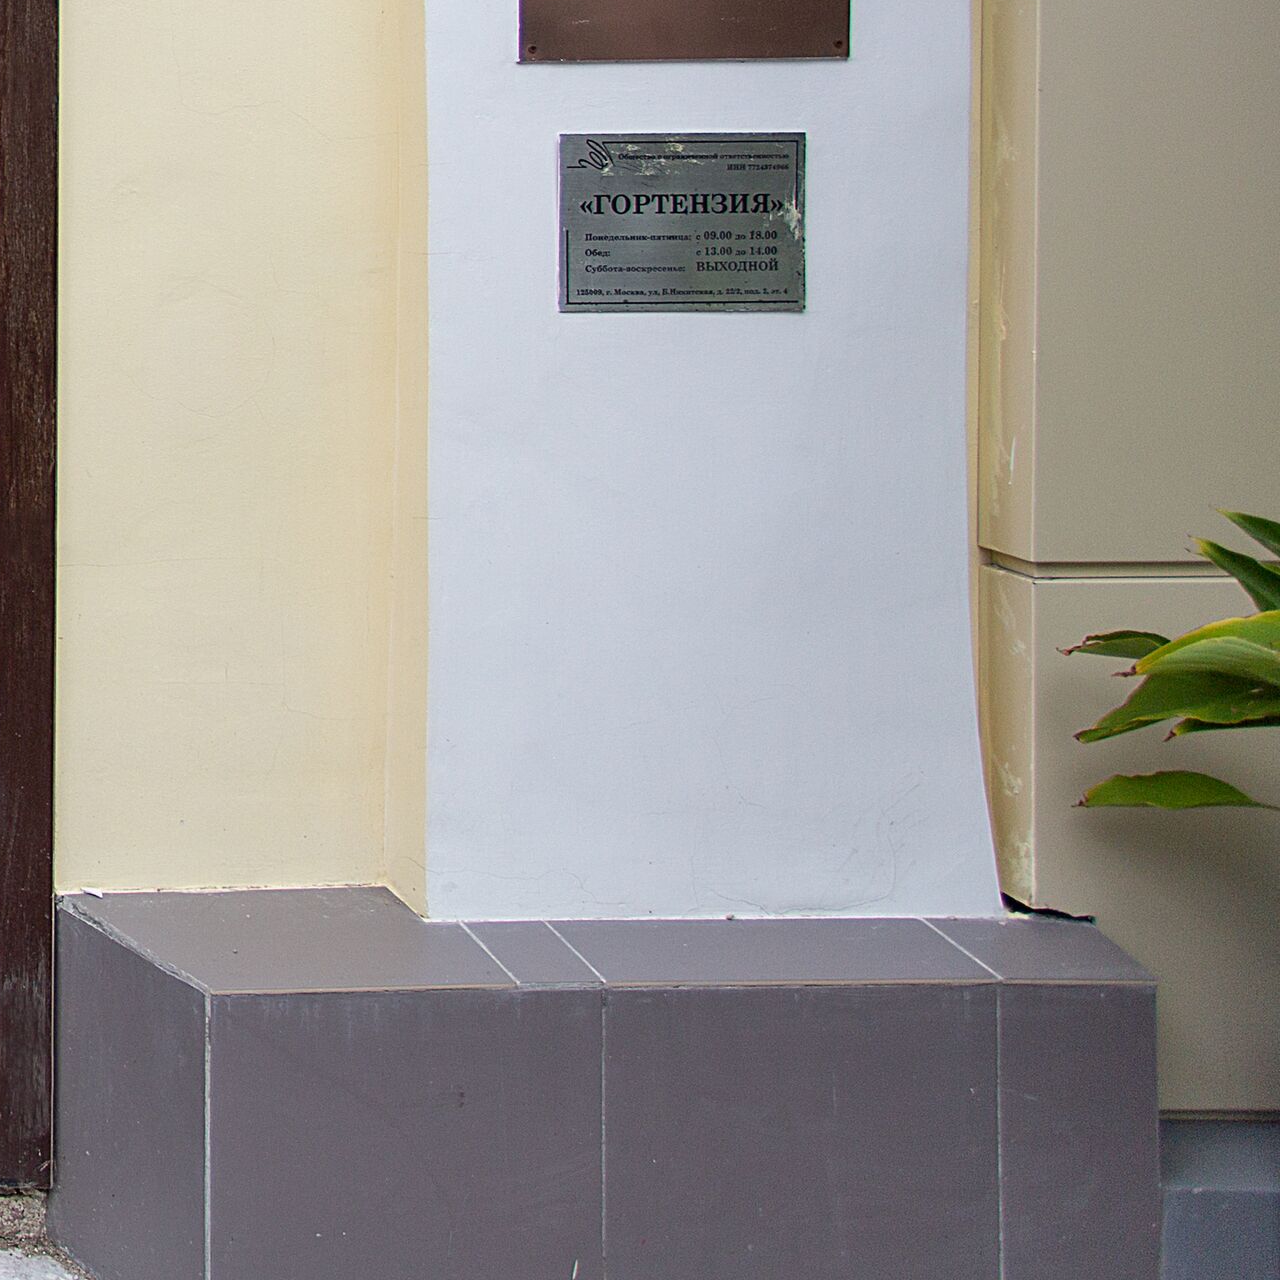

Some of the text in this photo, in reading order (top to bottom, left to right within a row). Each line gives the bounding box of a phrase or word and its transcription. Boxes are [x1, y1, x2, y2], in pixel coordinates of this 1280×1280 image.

[580, 193, 784, 214] «ГОРТЕНЗИЯ»
[585, 234, 690, 242] Понедельник-пятница:
[703, 231, 732, 240] 09.00
[749, 231, 777, 240] 18.00
[585, 249, 610, 257] Обед:
[705, 247, 732, 256] 13.00
[750, 247, 777, 255] 14.00
[696, 259, 778, 272] ВЫХОДНОЙ
